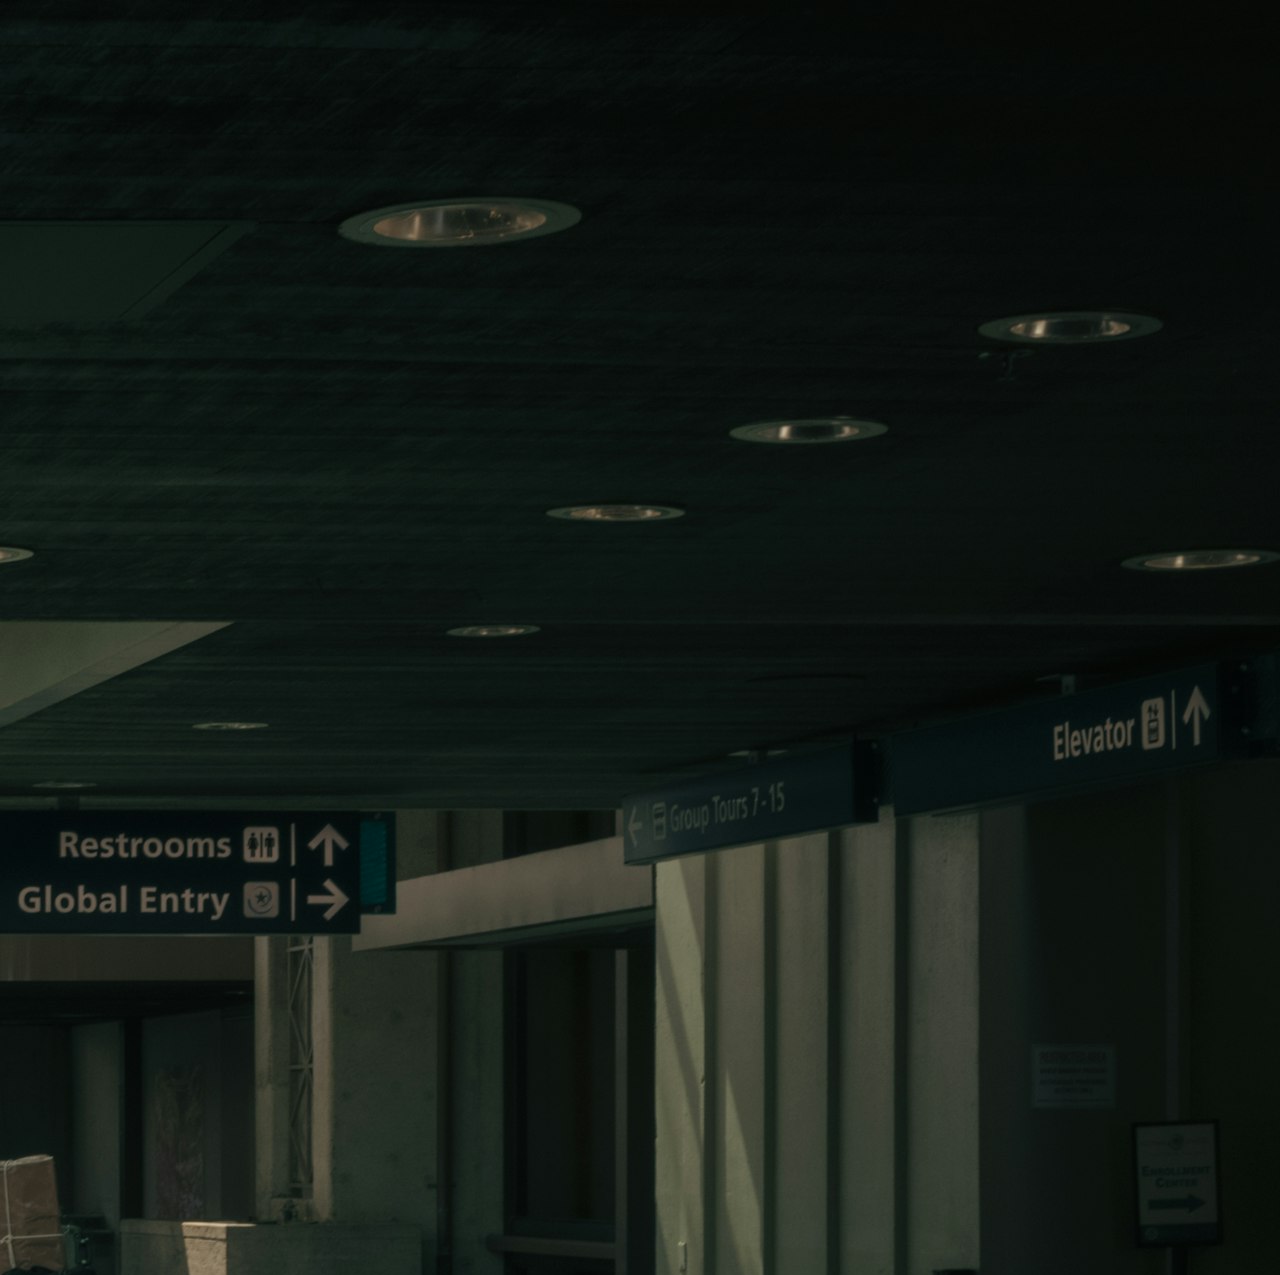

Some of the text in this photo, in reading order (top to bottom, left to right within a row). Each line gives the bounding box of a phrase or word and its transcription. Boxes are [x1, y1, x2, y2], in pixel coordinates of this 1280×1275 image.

[1053, 717, 1136, 761] Elevator
[670, 803, 710, 834] Group
[712, 795, 748, 824] Tours
[58, 831, 232, 859] Restrooms
[17, 884, 231, 921] Global Entry
